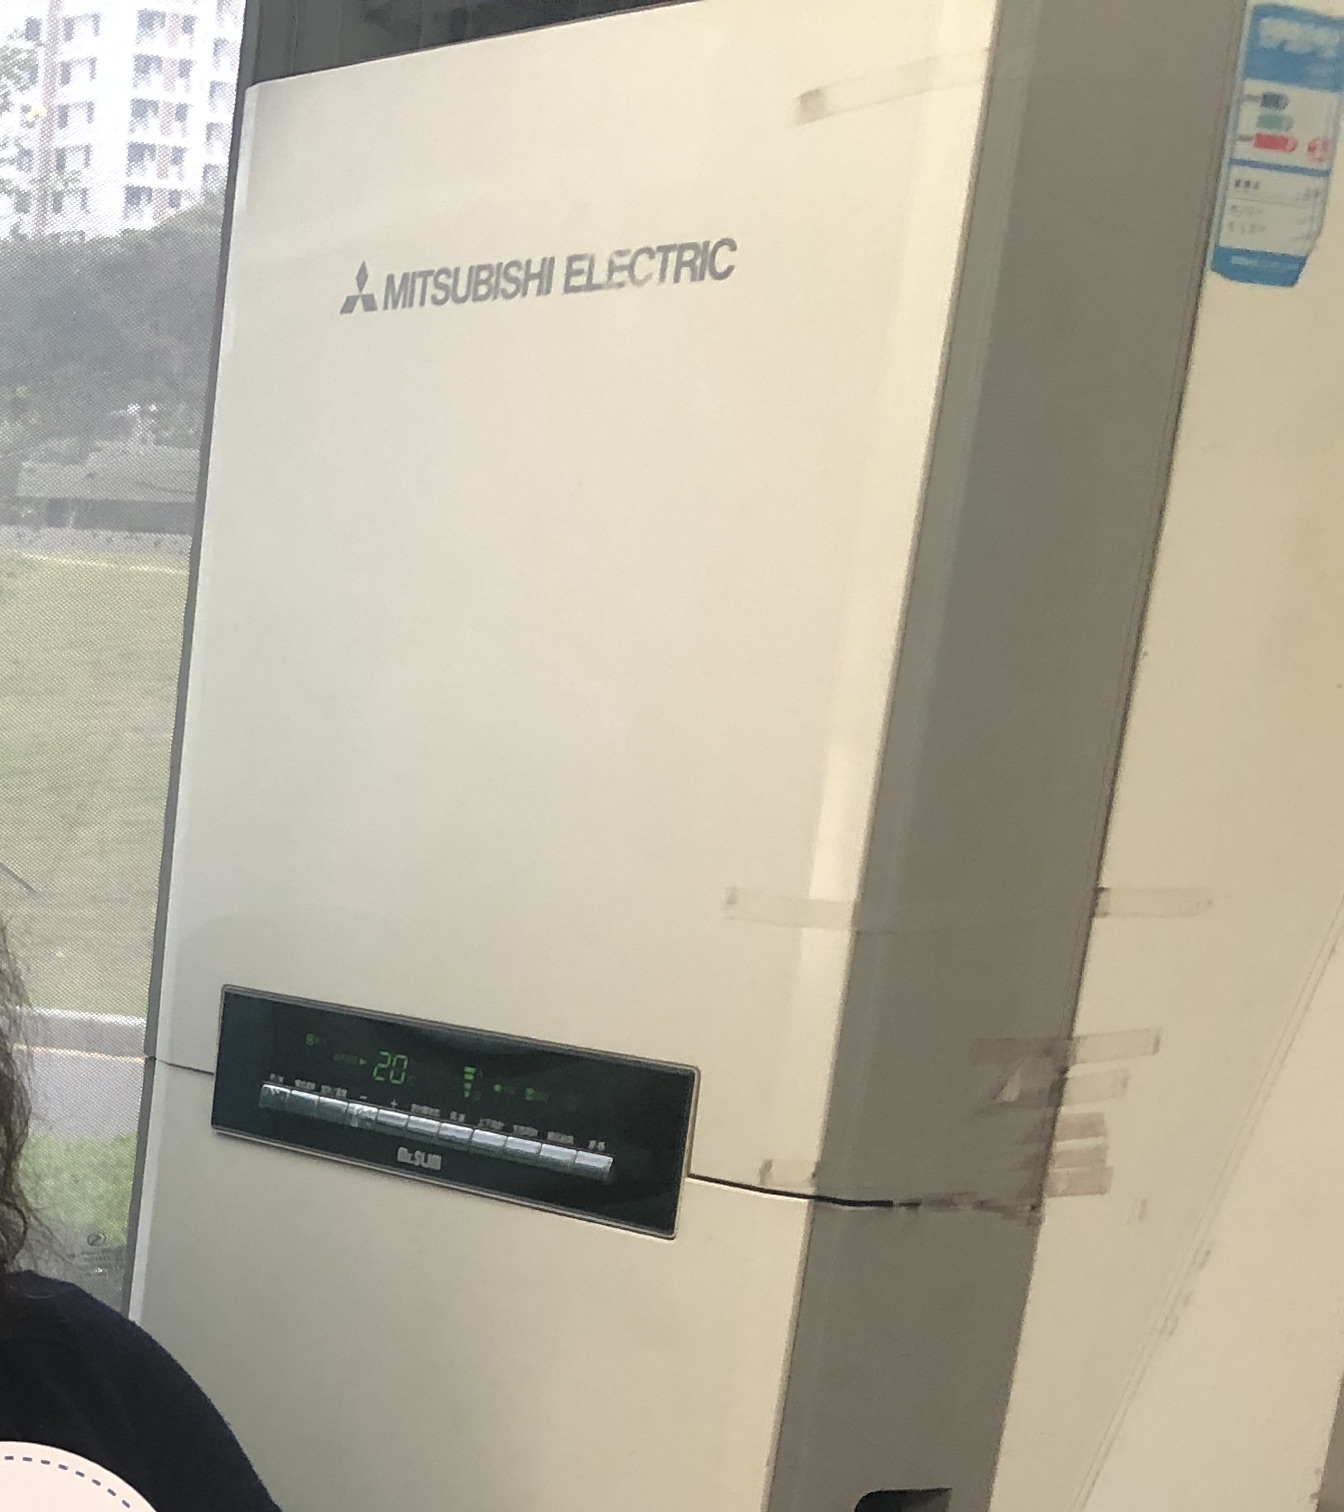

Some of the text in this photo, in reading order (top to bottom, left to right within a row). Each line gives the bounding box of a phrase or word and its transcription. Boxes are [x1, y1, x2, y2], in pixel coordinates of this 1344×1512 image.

[382, 238, 737, 311] MITSUBISHI ELECTRIC
[372, 1050, 409, 1085] 20
